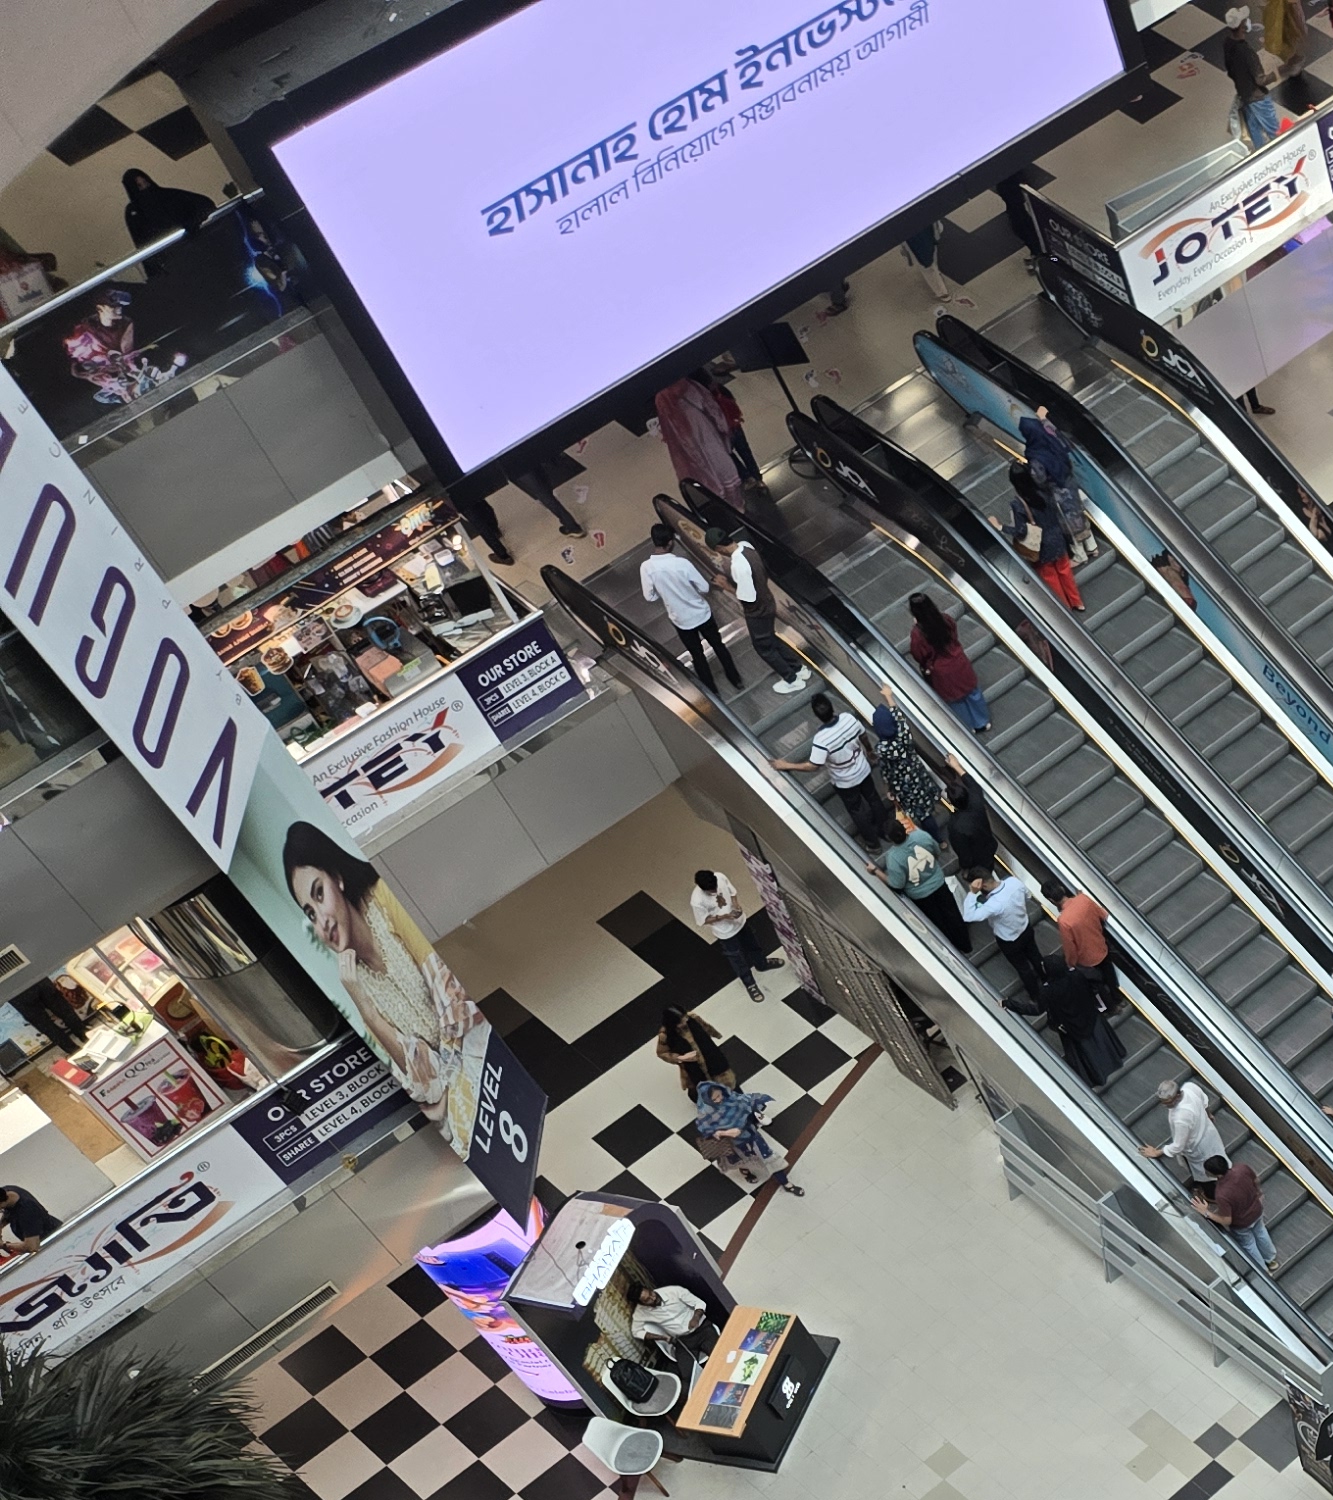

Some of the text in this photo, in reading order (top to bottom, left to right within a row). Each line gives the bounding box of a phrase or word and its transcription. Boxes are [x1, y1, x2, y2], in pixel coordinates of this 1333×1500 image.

[481, 70, 730, 236] হাসানাহ হোম
[556, 177, 629, 235] হালাল
[633, 118, 735, 193] বিনিয়োগে
[855, 1, 930, 61] আগামী
[1209, 200, 1222, 213] An
[1220, 177, 1254, 207] Exclusive
[1252, 160, 1280, 187] Fashion
[1278, 144, 1307, 171] House
[1153, 156, 1308, 286] JOTEY
[1157, 272, 1194, 302] Everyday,
[1192, 256, 1215, 282] Every
[1213, 236, 1248, 265] Occasion
[478, 640, 542, 688] OUR STORE
[502, 662, 549, 694] LEVEL BLOCK
[512, 678, 559, 710] LEVEL BLOCK
[1261, 662, 1333, 746] Beyond
[311, 696, 447, 787] An Exclusive Fashion House
[320, 706, 449, 810] TEY
[341, 800, 378, 830] ccasion
[273, 1064, 386, 1144] 3PCS LEVEL BLOCK
[311, 1046, 373, 1097] STORE
[281, 1080, 399, 1162] SHAREE LEVEL BLOCK
[474, 1065, 503, 1154] LEVEL
[499, 1109, 529, 1164] 8
[52, 1276, 126, 1331] প্রতি উৎসবে
